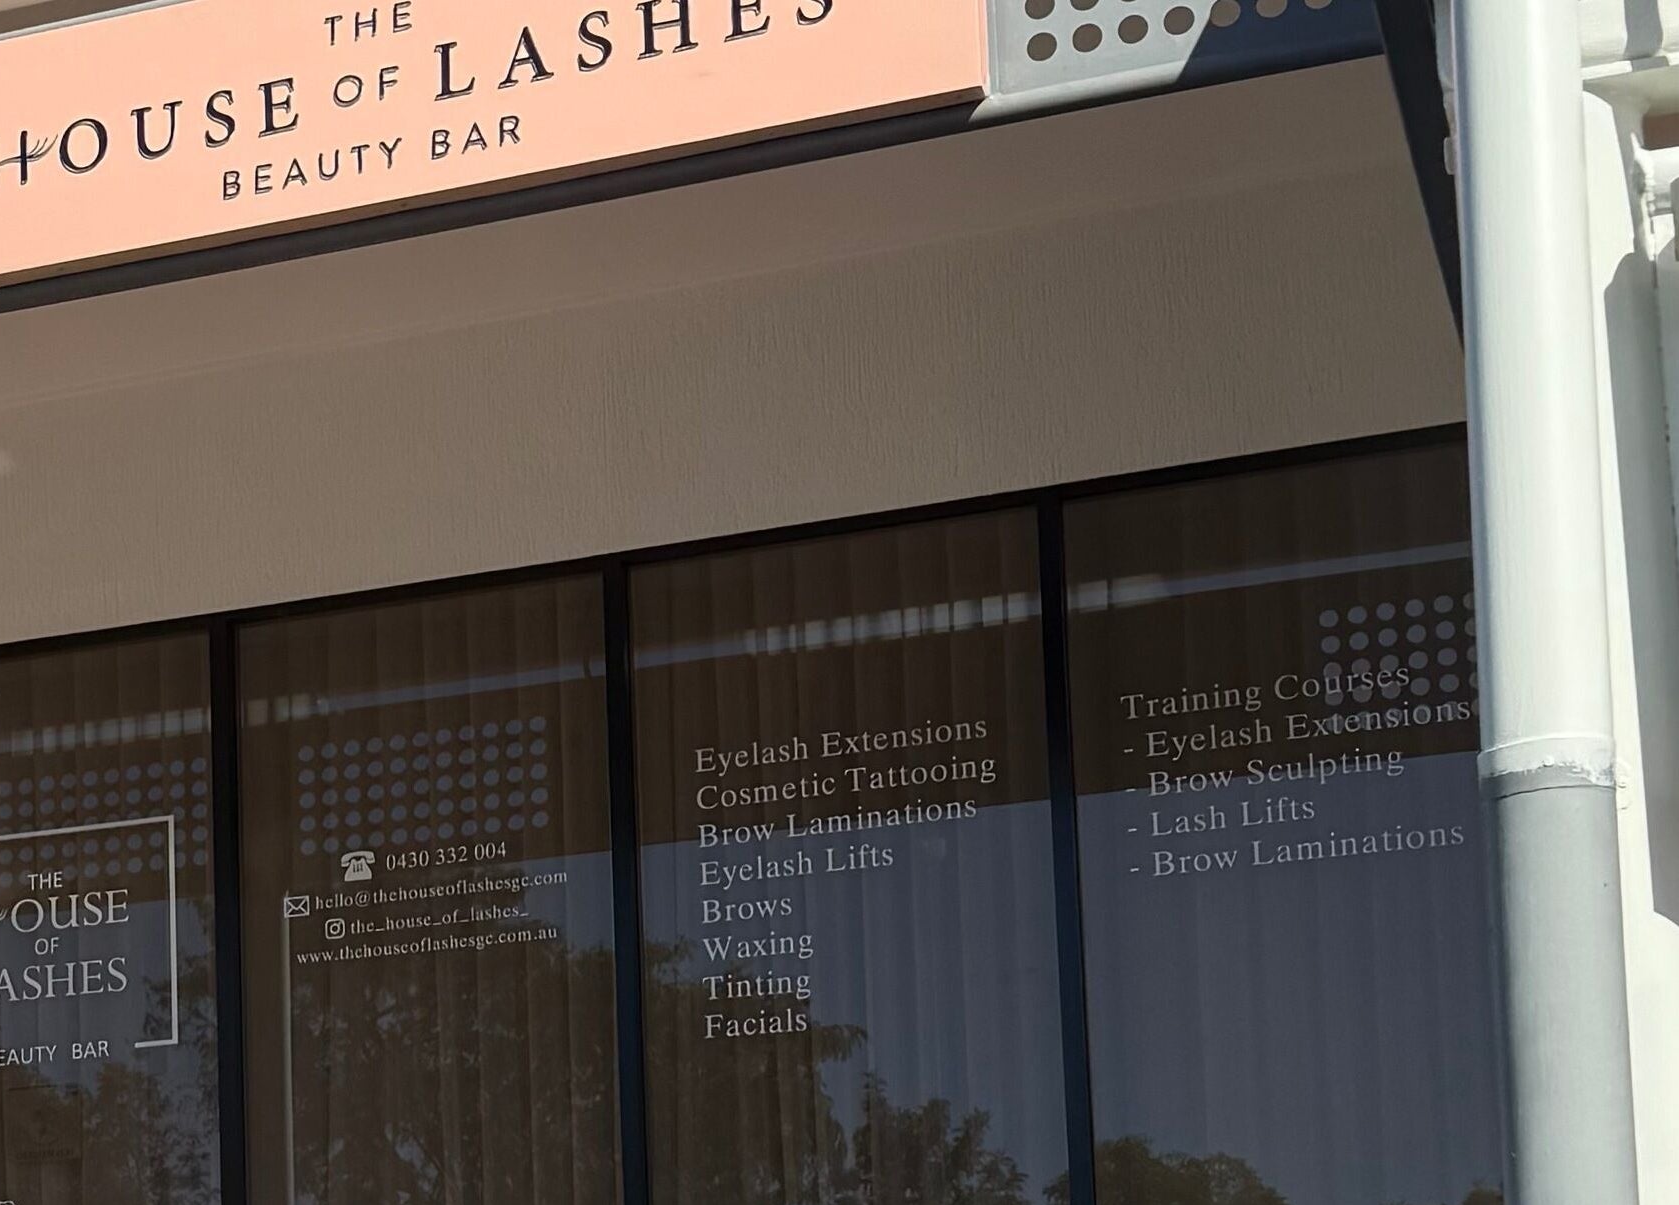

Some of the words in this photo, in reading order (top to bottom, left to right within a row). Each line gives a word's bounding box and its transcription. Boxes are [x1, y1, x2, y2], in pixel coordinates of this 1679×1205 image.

[324, 1, 413, 46] THE
[332, 66, 399, 107] OF
[222, 138, 402, 200] BEAUTY
[431, 115, 521, 160] BAR
[1120, 683, 1262, 719] Training
[1273, 667, 1410, 701] Courses
[695, 736, 809, 777] Eyelash
[821, 719, 988, 758] Extensions
[1146, 719, 1272, 760] Eyelash
[1285, 700, 1472, 740] Extensions
[696, 773, 836, 810] Cosmetic
[844, 755, 997, 793] Tattooing
[1149, 770, 1233, 796] Brow
[1247, 748, 1405, 785] Sculpting
[698, 822, 775, 849] Brow
[786, 798, 977, 839] Laminations
[1151, 805, 1226, 837] Lash
[1241, 797, 1315, 827] Lifts
[386, 851, 429, 871] 0430
[435, 846, 468, 866] 332
[475, 841, 507, 860] 004
[699, 851, 813, 890] Eyelash
[826, 844, 894, 872] Lifts
[1153, 850, 1238, 877] Brow
[1252, 824, 1464, 866] Laminations
[27, 871, 63, 891] THE
[702, 897, 793, 924] Brows
[34, 937, 59, 955] OF
[703, 931, 814, 961] Waxing
[702, 970, 811, 1000] Tinting
[703, 1008, 807, 1039] Facials
[72, 1040, 110, 1060] BAR
